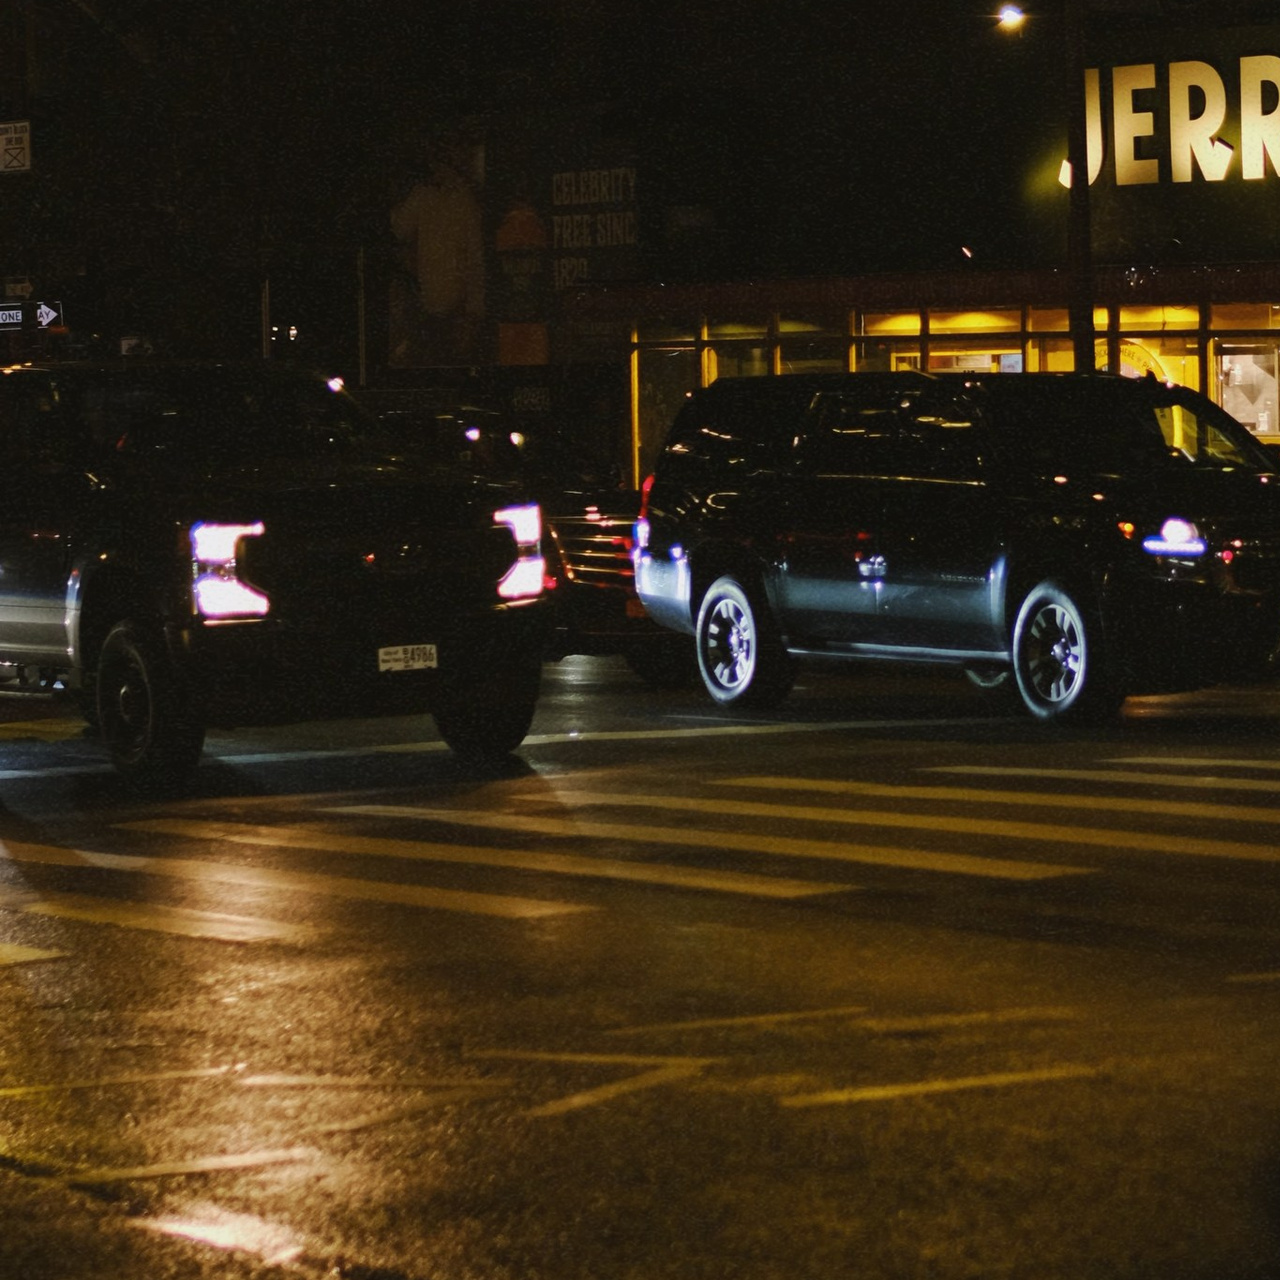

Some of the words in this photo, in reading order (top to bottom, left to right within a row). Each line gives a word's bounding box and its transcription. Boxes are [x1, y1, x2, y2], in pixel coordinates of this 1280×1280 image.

[552, 167, 637, 206] CELEBRITY
[552, 213, 592, 249] FREE
[1, 311, 21, 322] ONE
[38, 310, 51, 320] AY
